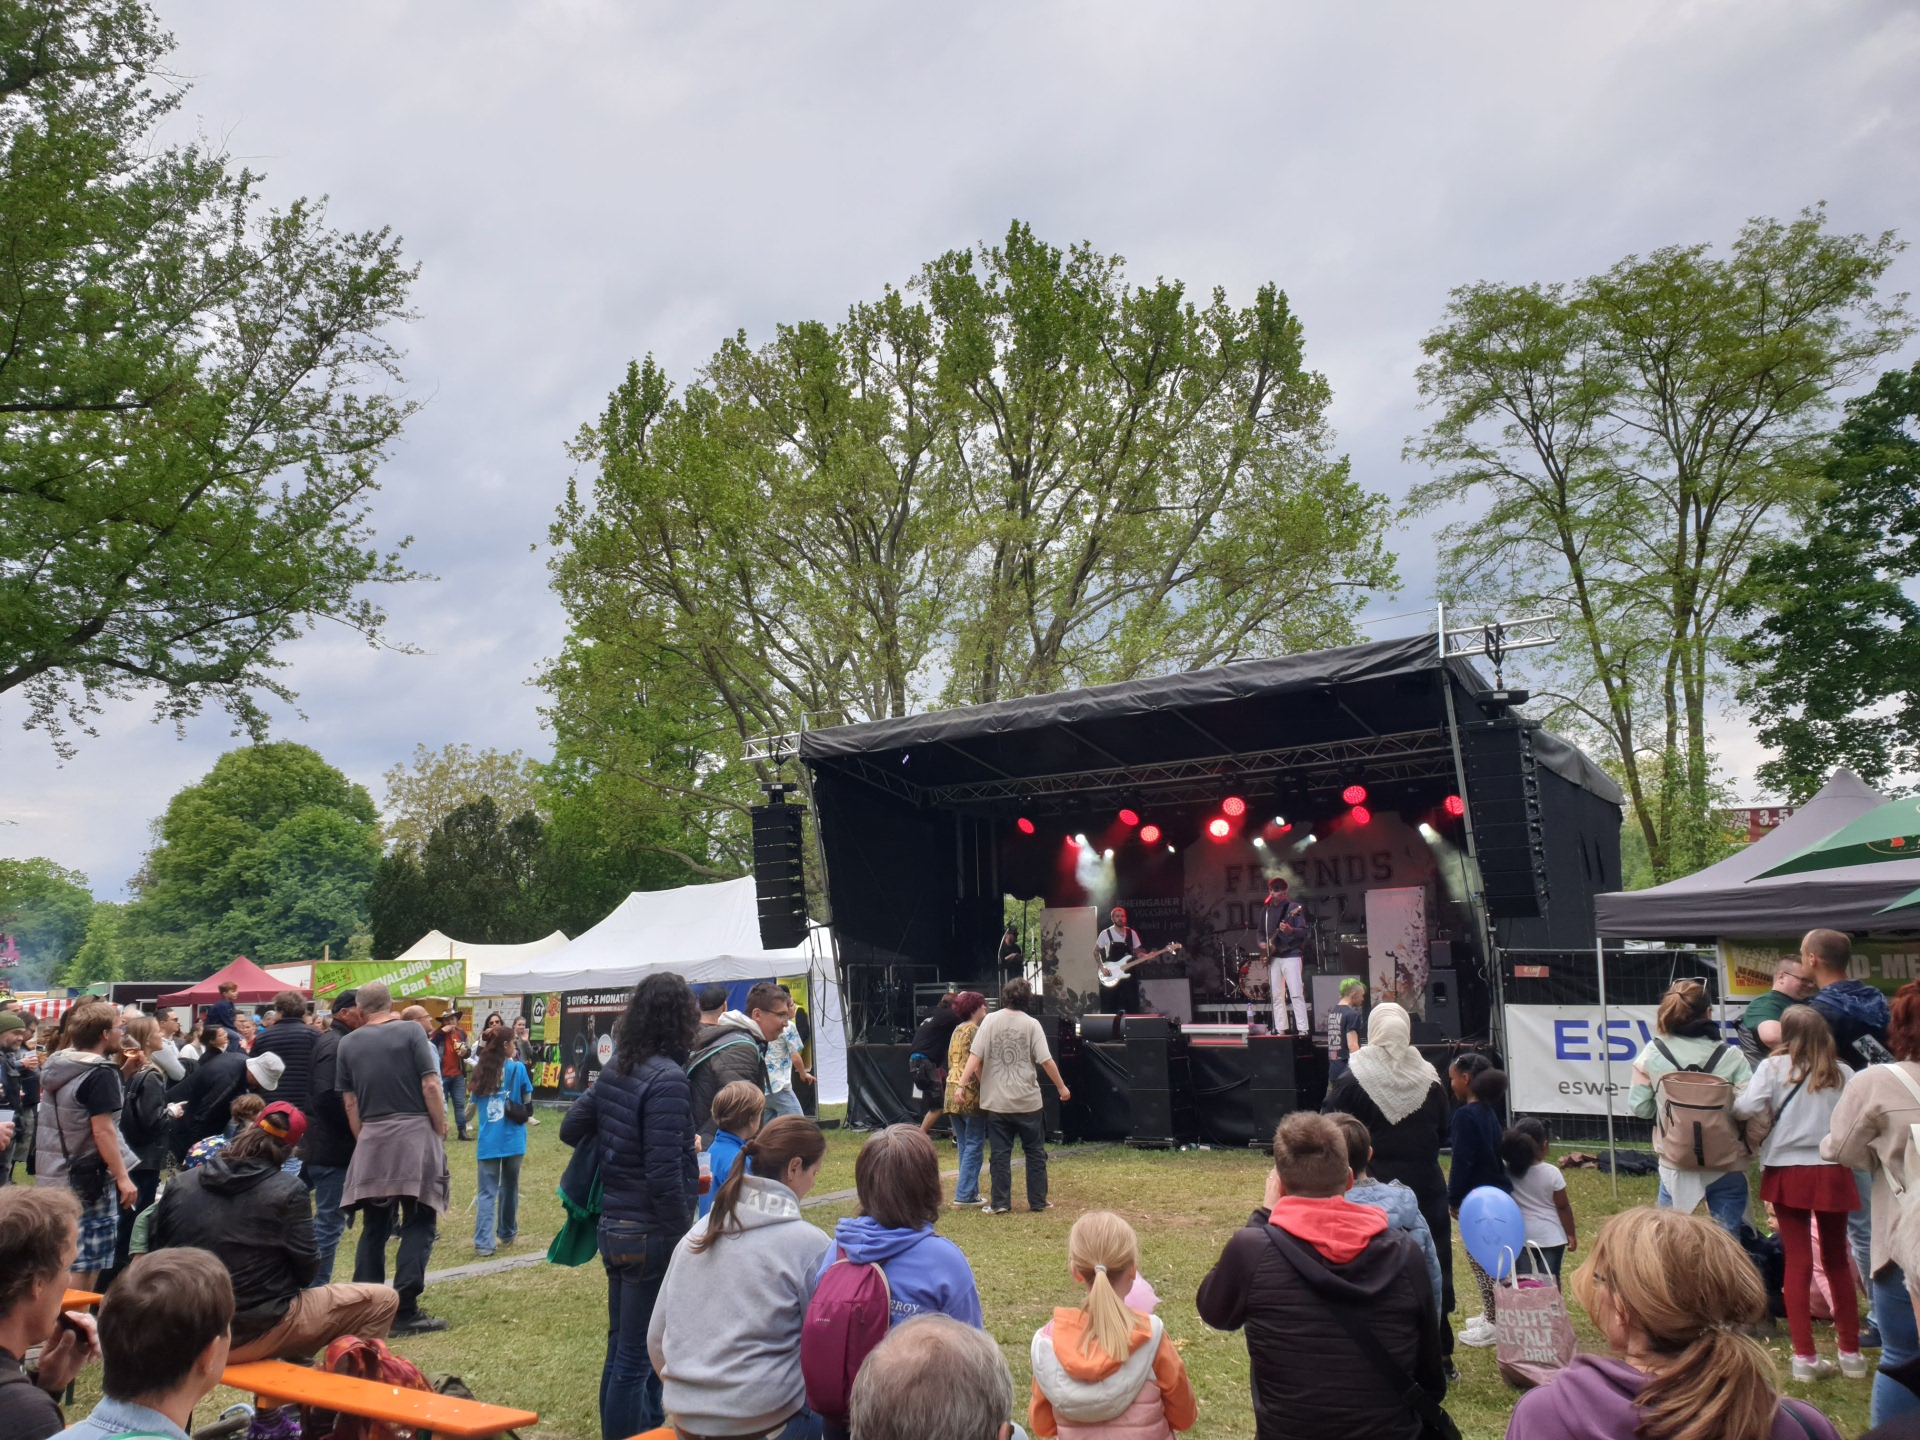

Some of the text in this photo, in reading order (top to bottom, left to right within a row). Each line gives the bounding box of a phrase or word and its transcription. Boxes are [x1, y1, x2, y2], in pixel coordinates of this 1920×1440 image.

[599, 993, 630, 1004] MONATE
[1554, 1019, 1740, 1061] ES
[599, 1044, 611, 1055] AFC
[889, 1299, 921, 1315] ERGY
[1497, 1308, 1552, 1327] ECHTE
[1498, 1327, 1553, 1347] ELFALT
